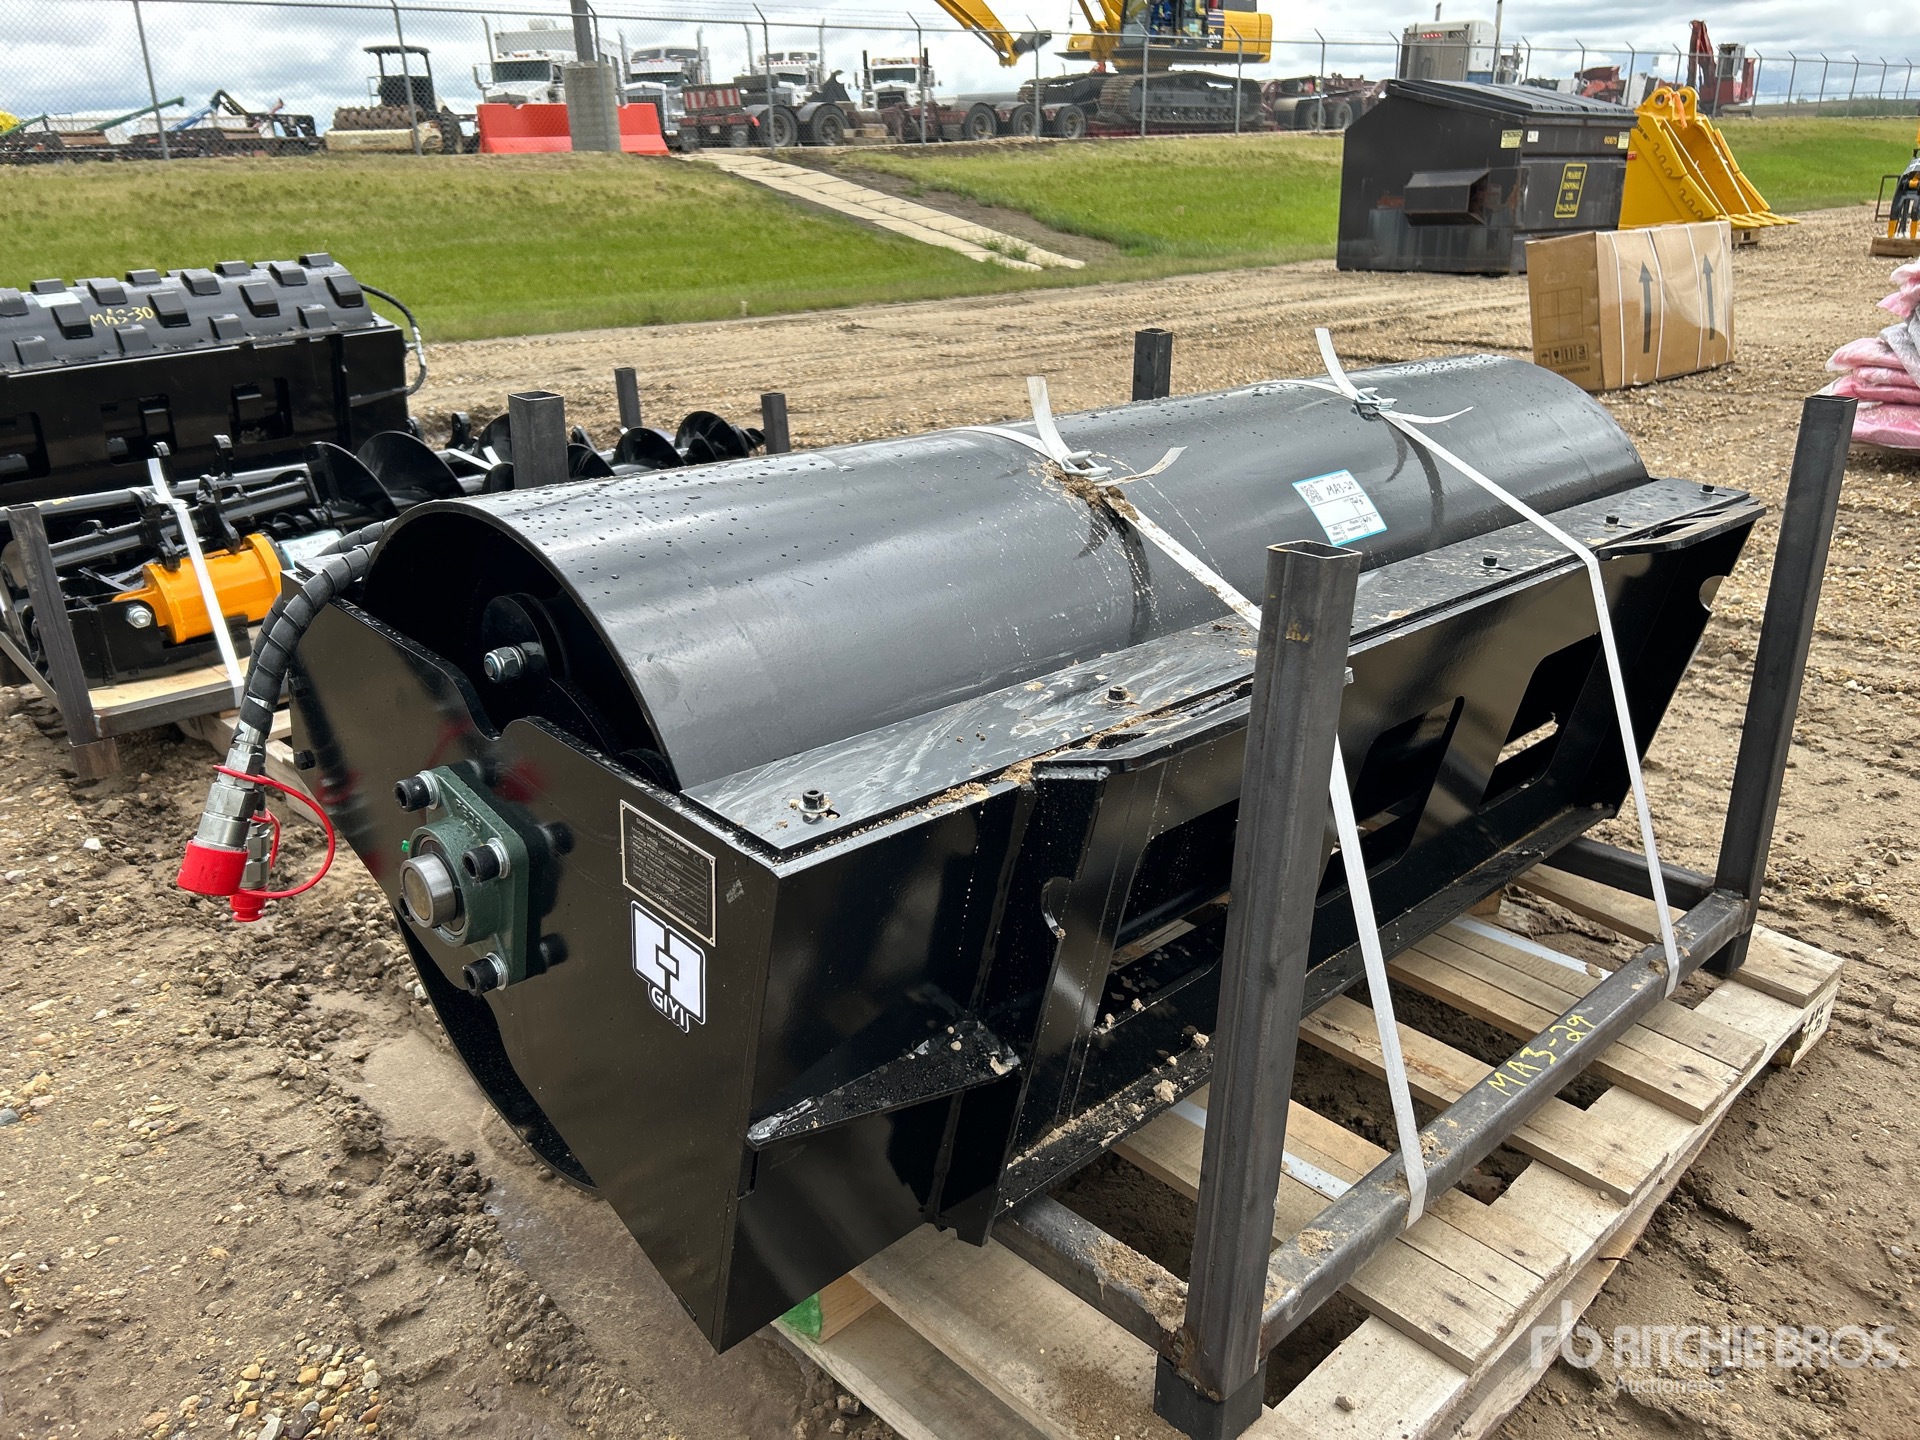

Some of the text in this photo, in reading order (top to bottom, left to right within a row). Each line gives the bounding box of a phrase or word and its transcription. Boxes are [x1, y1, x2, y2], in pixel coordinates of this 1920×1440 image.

[1326, 481, 1356, 496] MA3-29
[652, 986, 684, 1027] GIYI
[1486, 1014, 1597, 1096] MA3-29
